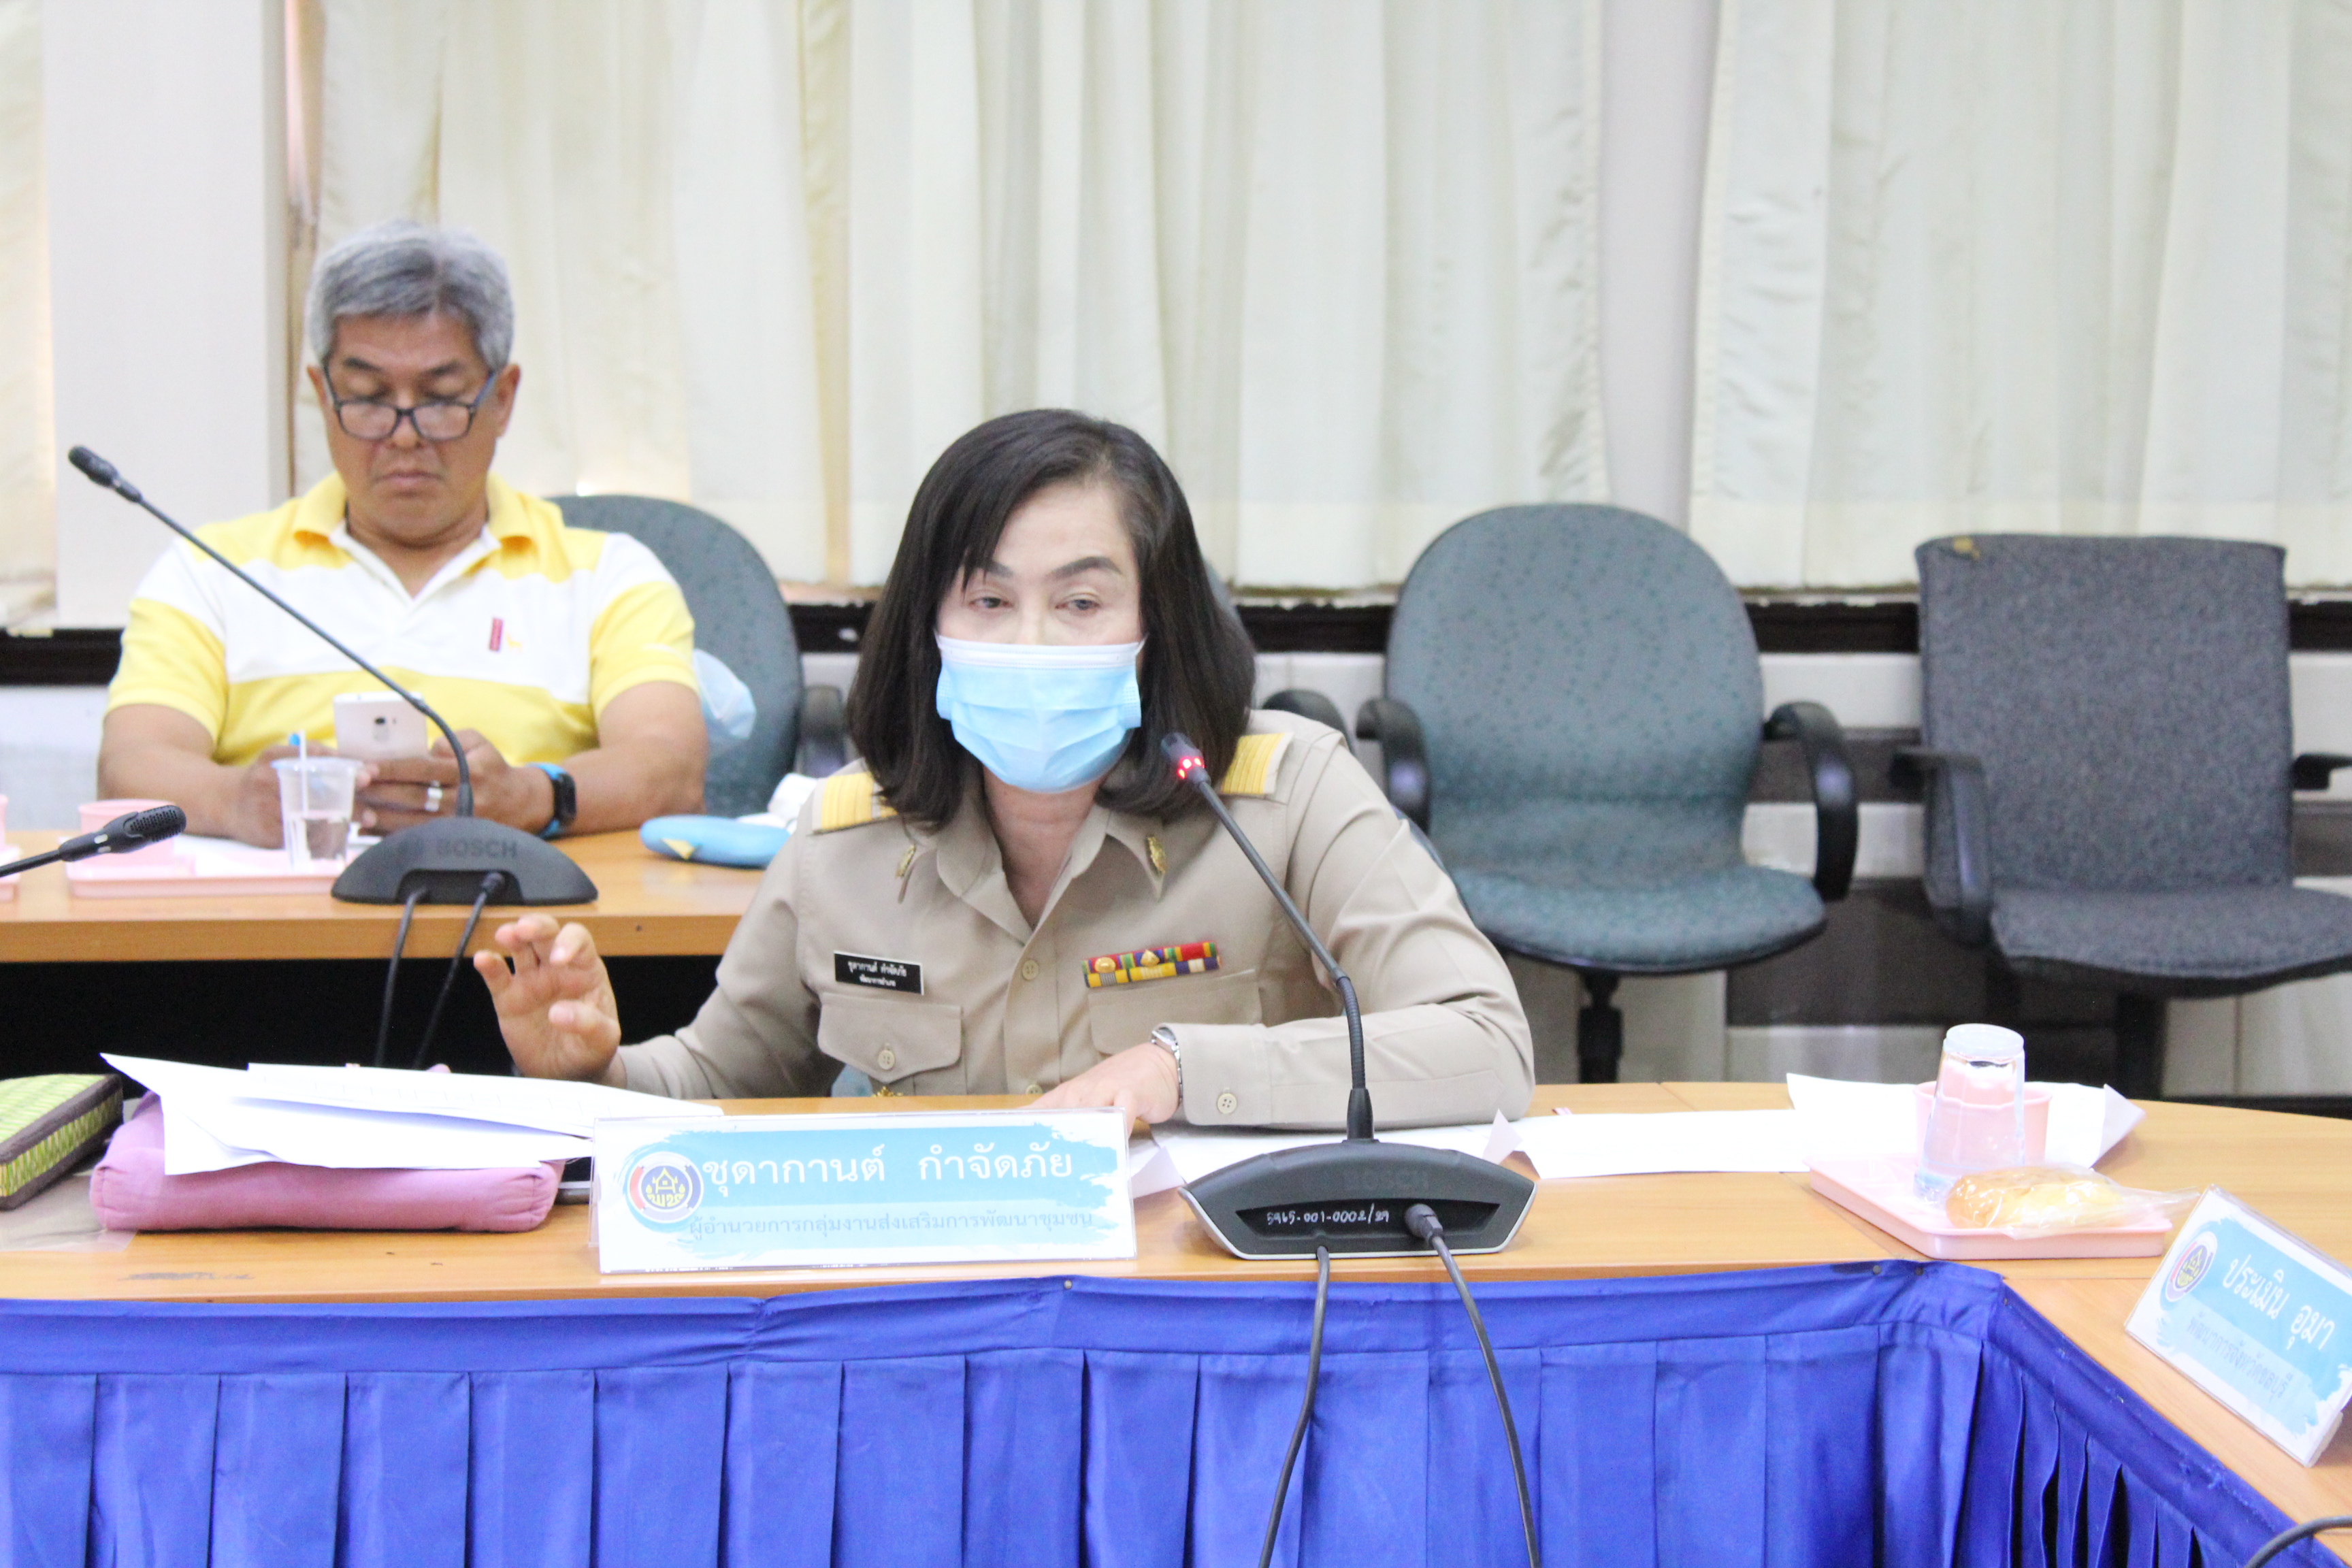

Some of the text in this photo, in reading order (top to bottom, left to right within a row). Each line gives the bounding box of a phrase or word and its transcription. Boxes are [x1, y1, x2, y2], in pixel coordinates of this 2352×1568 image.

[437, 838, 518, 858] BOSCH
[703, 1139, 1073, 1196] ชุดากานต์ กำจัดภัย
[689, 1210, 1092, 1241] ผู้อำนวยการกลุ่มงานส่งเสริมการพัฒนาชุมชน
[2223, 1254, 2335, 1350] ประเมิน อุมา
[2187, 1312, 2293, 1401] พัฒนาการจังหวัดชลบุรี
